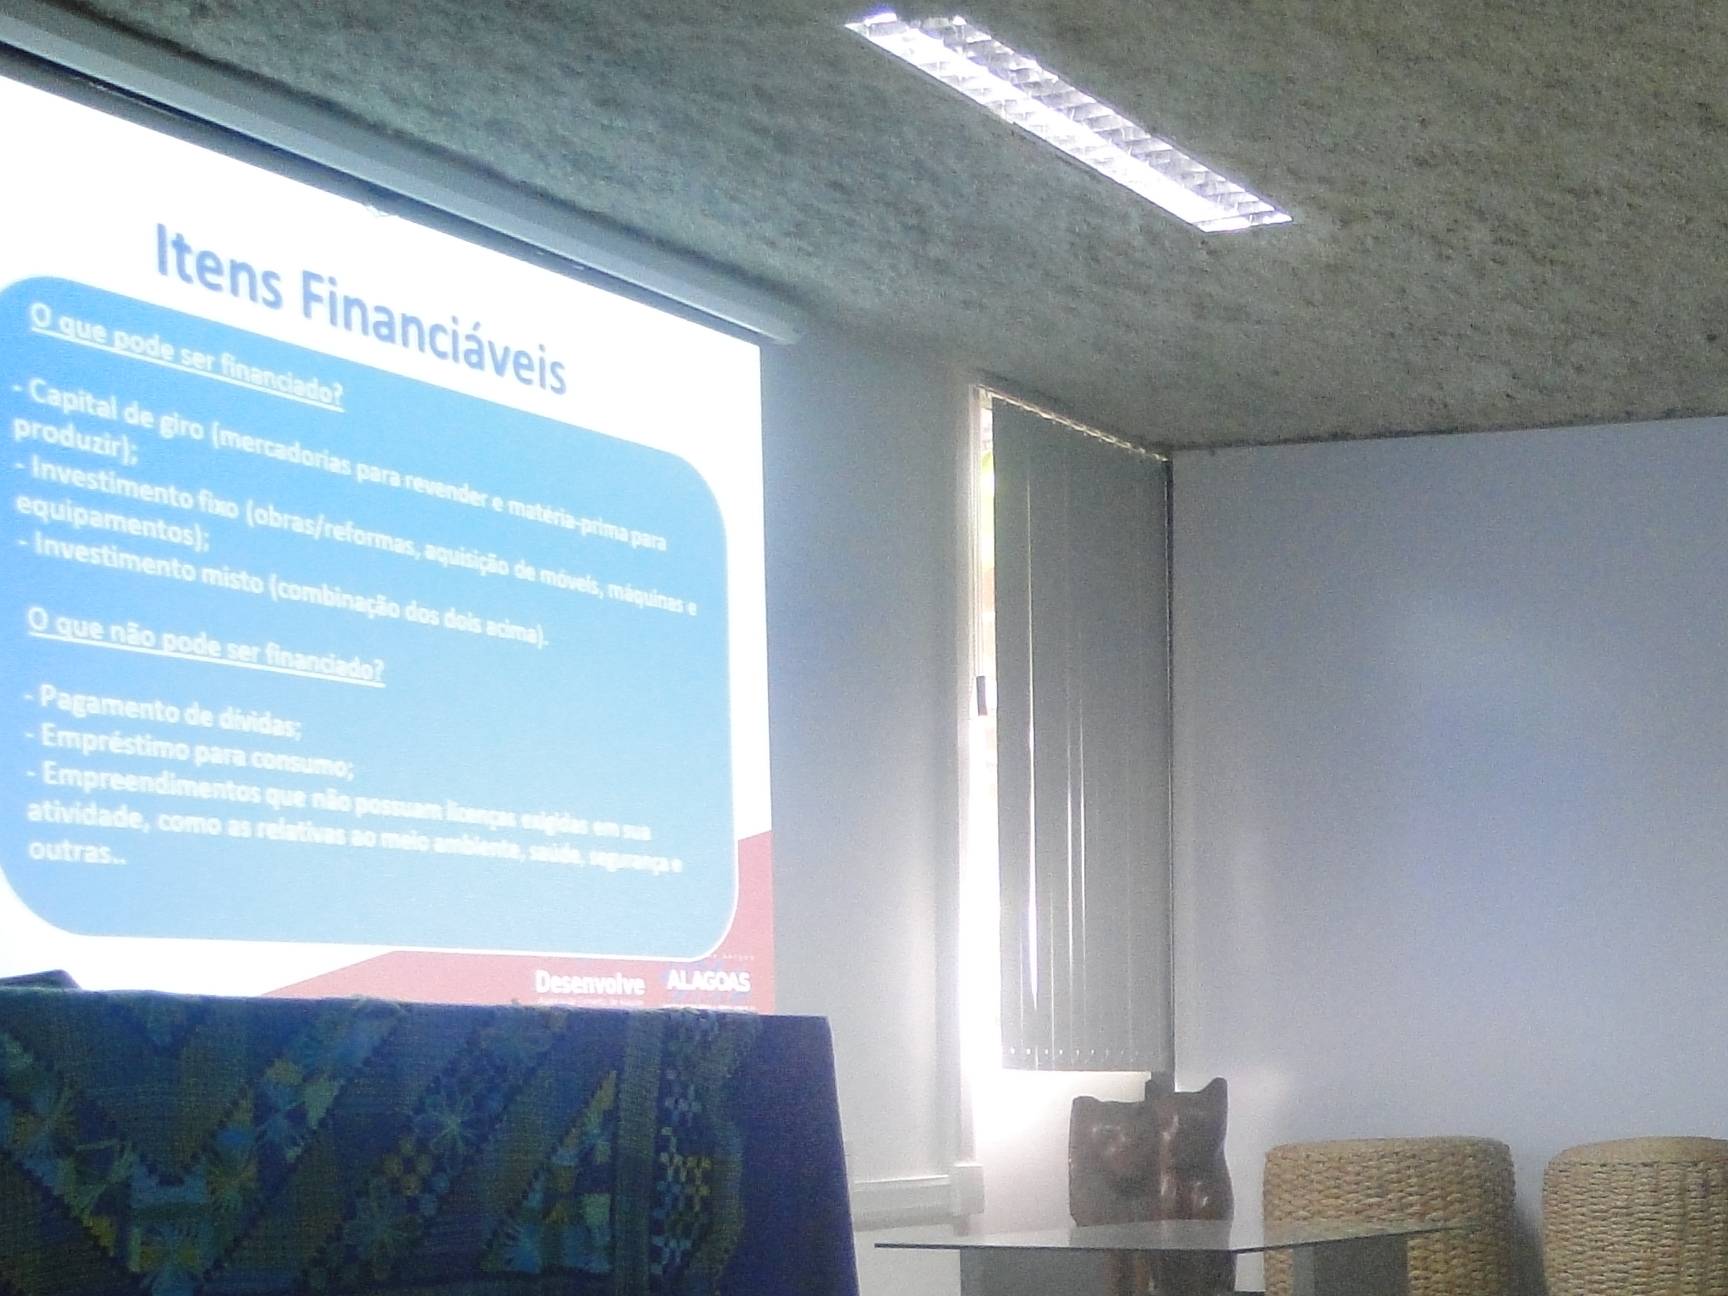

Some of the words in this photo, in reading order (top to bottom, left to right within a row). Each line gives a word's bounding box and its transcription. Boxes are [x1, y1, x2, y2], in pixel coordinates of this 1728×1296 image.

[156, 223, 282, 310] Itens
[302, 269, 567, 395] Financiáveis
[30, 303, 50, 328] O
[59, 314, 107, 343] que
[114, 327, 174, 360] pode
[181, 347, 215, 371] ser
[221, 353, 345, 405] financiado?
[13, 418, 138, 466] produzir);
[29, 378, 117, 421] Capital
[124, 401, 154, 428] de
[160, 411, 204, 439] giro
[212, 421, 351, 475] (mercadorias
[357, 462, 401, 487] para
[405, 475, 488, 508] revender
[493, 497, 504, 511] e
[631, 530, 667, 551] para
[16, 496, 210, 553] equipamentos);
[32, 455, 194, 510] Investimento
[199, 489, 239, 519] fixo
[515, 559, 536, 581] de
[35, 531, 196, 582] Investimento
[201, 566, 265, 594] misto
[405, 600, 440, 626] dos
[444, 608, 482, 633] dois
[28, 606, 48, 631] O
[56, 616, 104, 640] que
[110, 622, 156, 648] não
[162, 632, 222, 658] pode
[227, 643, 260, 663] ser
[266, 642, 385, 681] financiado?
[40, 684, 181, 724] Pagamento
[185, 702, 214, 727] de
[41, 722, 190, 761] Empréstimo
[195, 744, 246, 767] para
[251, 751, 354, 782] consumo;
[43, 760, 262, 804] Empreendimentos
[265, 787, 307, 810] que
[27, 799, 151, 834] atividade,
[157, 813, 223, 836] como
[227, 819, 251, 838] as
[535, 968, 646, 996] Desenvolve
[667, 968, 751, 993] ALAGOAS
